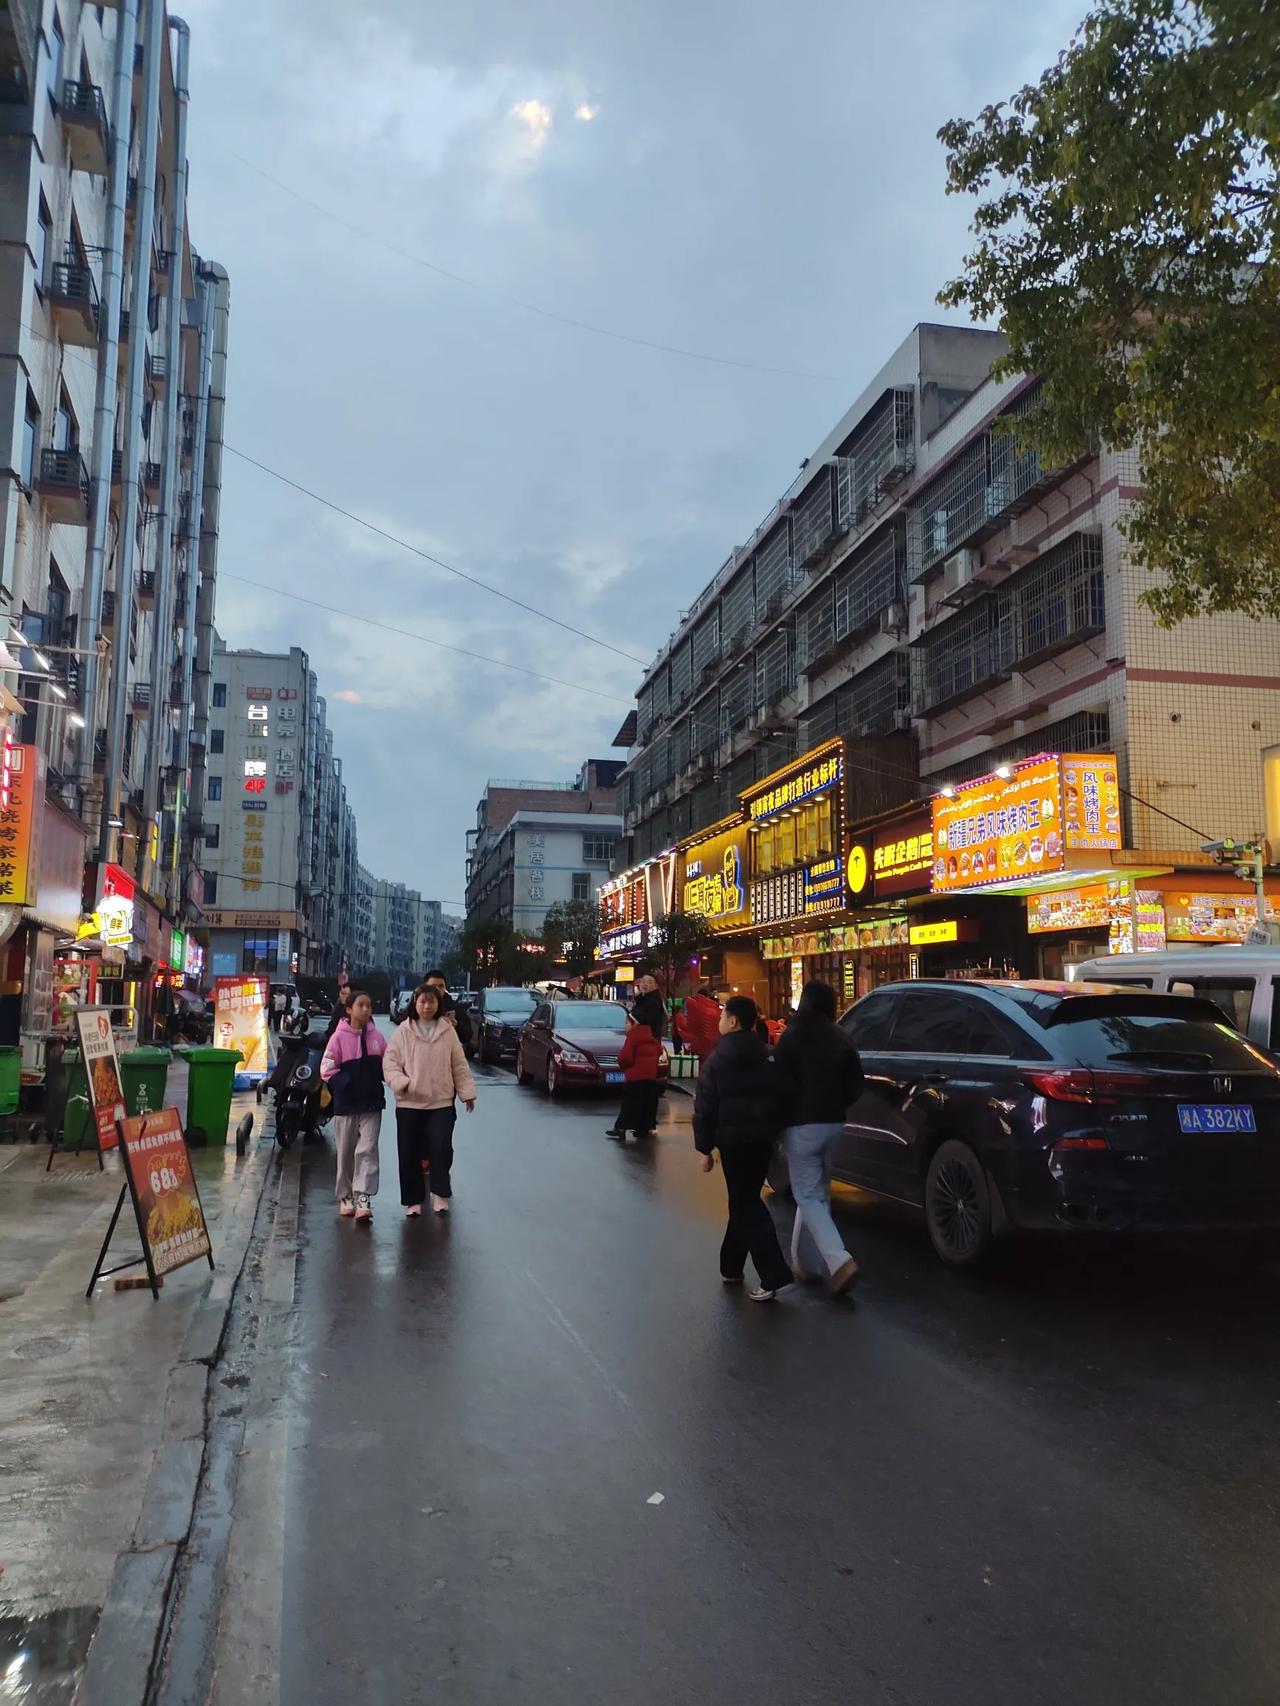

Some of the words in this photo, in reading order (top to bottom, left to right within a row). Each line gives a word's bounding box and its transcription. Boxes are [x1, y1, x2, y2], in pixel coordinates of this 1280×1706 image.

[948, 798, 1041, 851] 新疆兄弟风味烤肉王
[1083, 771, 1100, 835] 风味烤肉王
